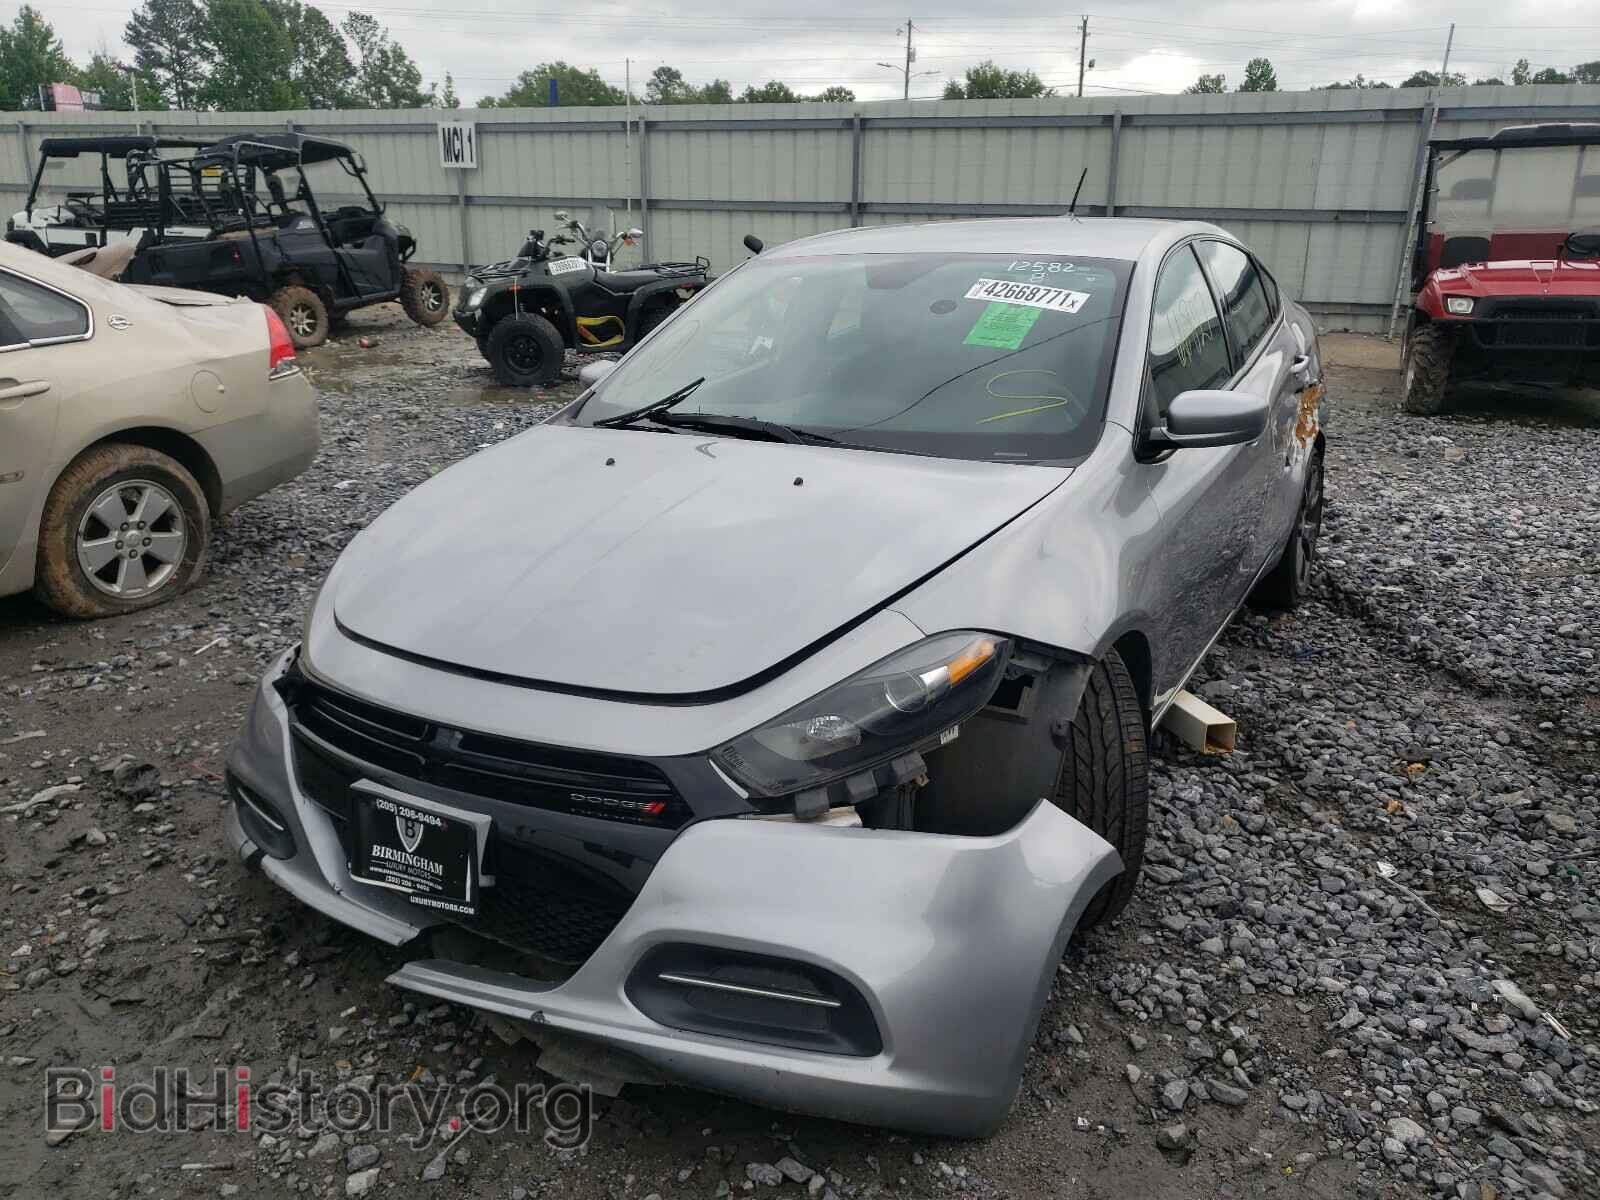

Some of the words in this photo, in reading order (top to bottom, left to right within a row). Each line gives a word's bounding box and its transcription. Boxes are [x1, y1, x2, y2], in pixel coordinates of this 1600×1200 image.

[442, 127, 464, 163] MCI
[467, 127, 474, 163] 1
[1007, 261, 1077, 273] 12582
[376, 799, 398, 816] (205)
[570, 793, 654, 811] DODGE
[371, 844, 444, 877] BIRMINGHAM
